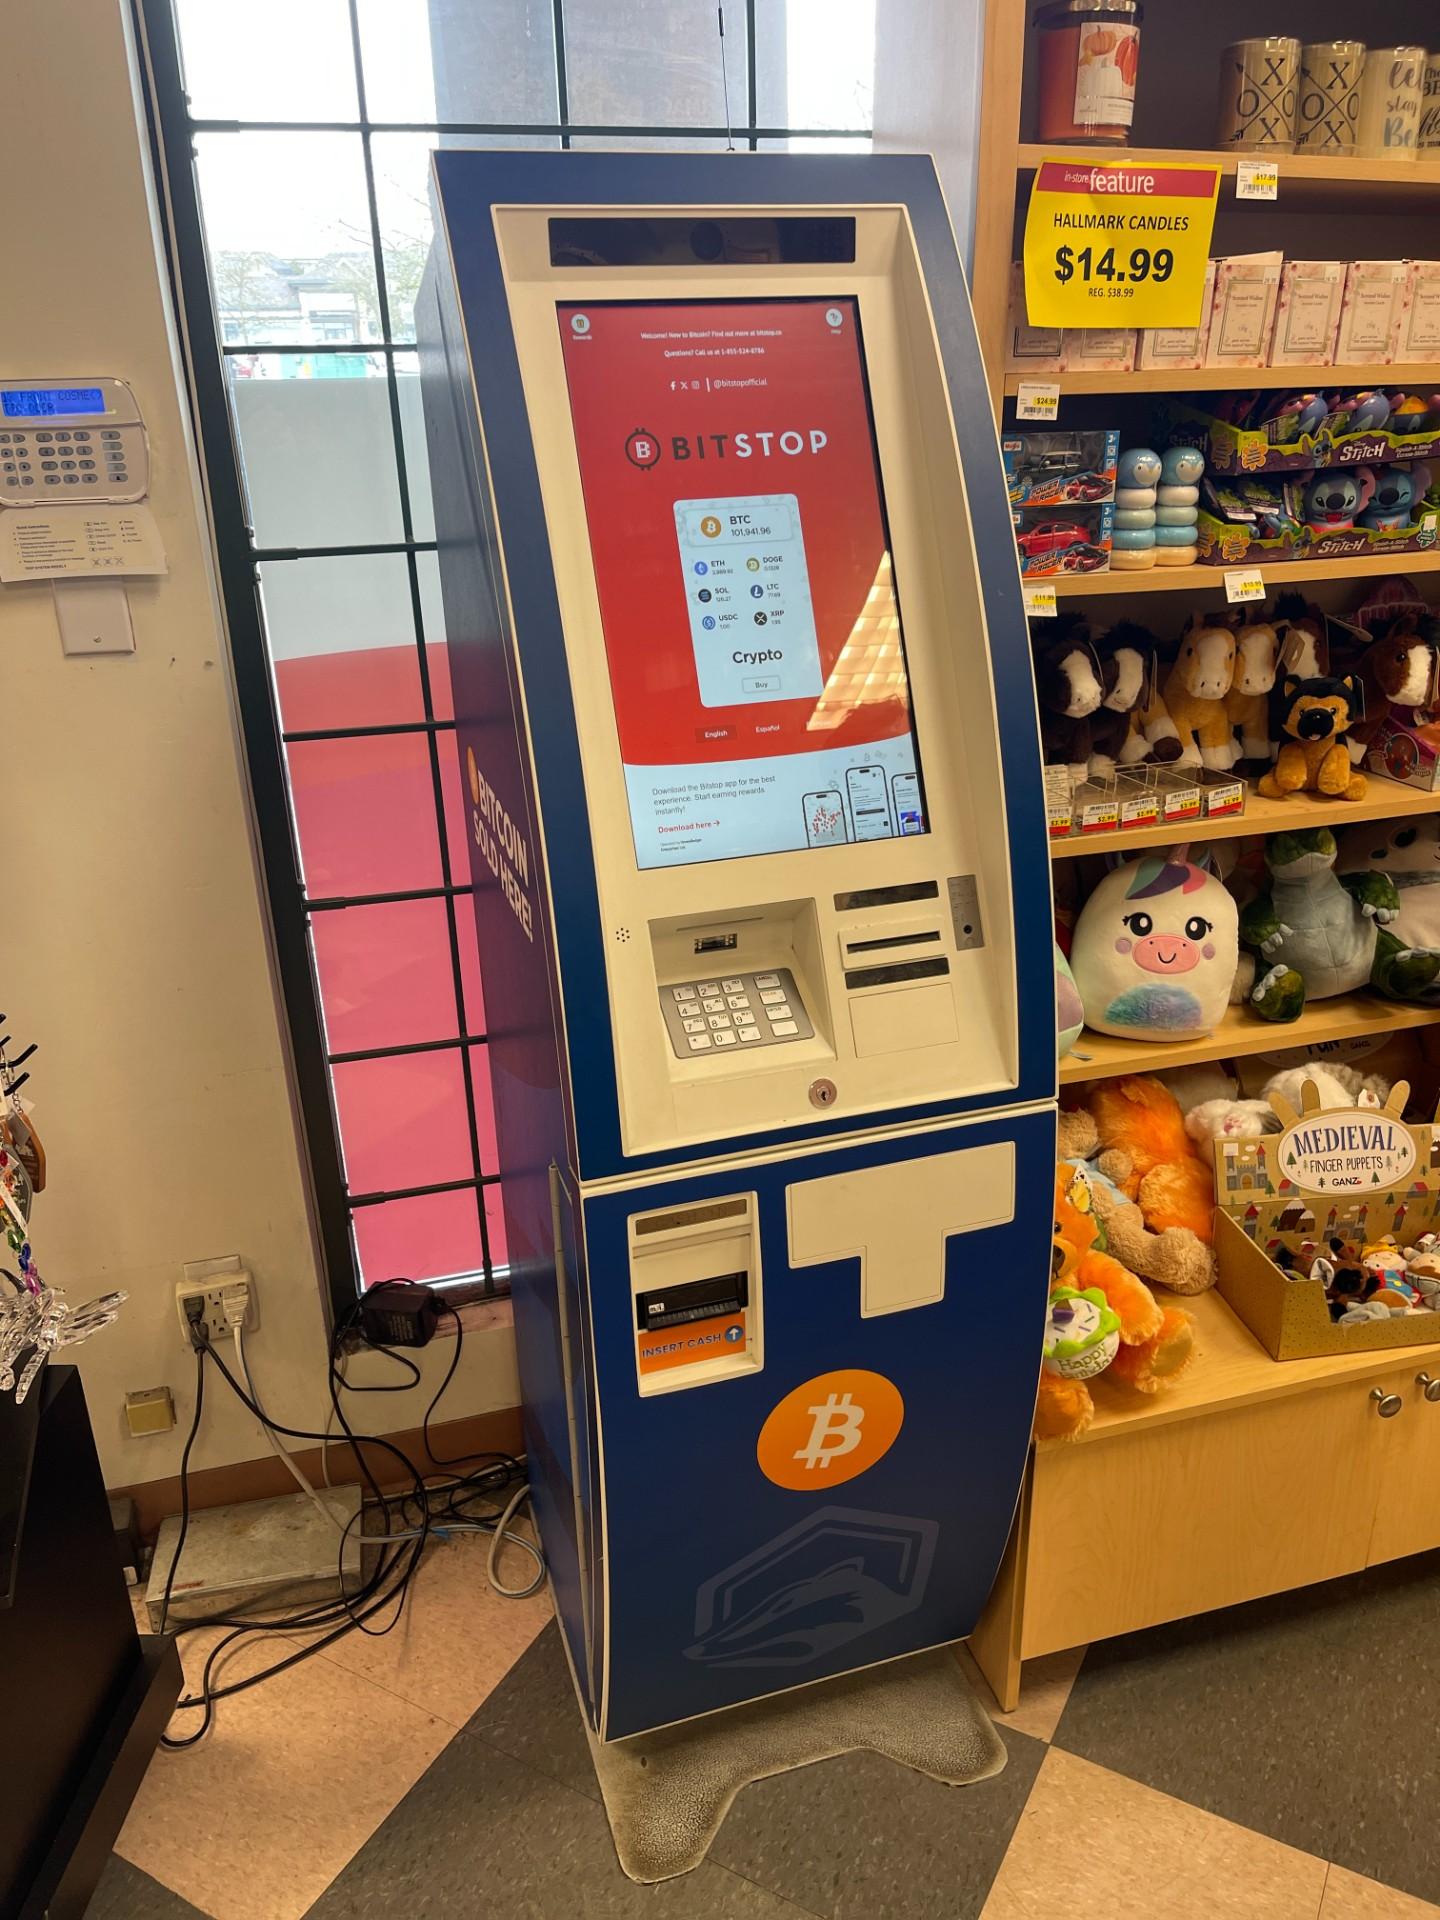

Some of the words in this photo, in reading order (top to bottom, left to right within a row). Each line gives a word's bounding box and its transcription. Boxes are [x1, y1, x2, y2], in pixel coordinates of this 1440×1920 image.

[1089, 167, 1155, 193] feature
[1053, 212, 1126, 230] HALLMARK
[1128, 215, 1190, 232] CANDLES
[1054, 244, 1174, 285] $14.99
[1088, 287, 1106, 297] REG.
[1107, 288, 1134, 298] $38.99
[713, 377, 768, 390] @bitstopofficial
[672, 430, 828, 461] BITSTOP
[729, 515, 751, 525] BTC
[731, 526, 771, 537] 101,941.96
[711, 560, 725, 568] ETH
[732, 648, 783, 665] Crypto
[705, 730, 728, 739] English
[756, 724, 780, 734] Español
[652, 785, 687, 796] Download
[688, 783, 699, 792] the
[700, 781, 724, 791] Bitstop
[725, 780, 737, 788] app
[738, 778, 748, 786] for
[749, 777, 760, 785] the
[761, 775, 776, 783] best
[694, 792, 711, 801] Start
[712, 790, 737, 799] earning
[655, 806, 686, 816] instantly!
[477, 769, 529, 888] BITCOIN
[658, 821, 694, 834] Download
[695, 821, 712, 829] here
[473, 809, 498, 877] SOLD
[499, 854, 533, 944] HERE!
[701, 988, 707, 996] 2
[682, 1007, 688, 1015] 4
[716, 1034, 723, 1042] 0
[1293, 1125, 1396, 1157] MEDIEVAL
[1310, 1158, 1343, 1173] FINGER
[1346, 1156, 1384, 1171] PUPPETS
[1332, 1177, 1359, 1187] GANZ
[642, 1341, 684, 1359] INSERT
[687, 1333, 721, 1348] CASH
[1057, 1343, 1107, 1371] Happy
